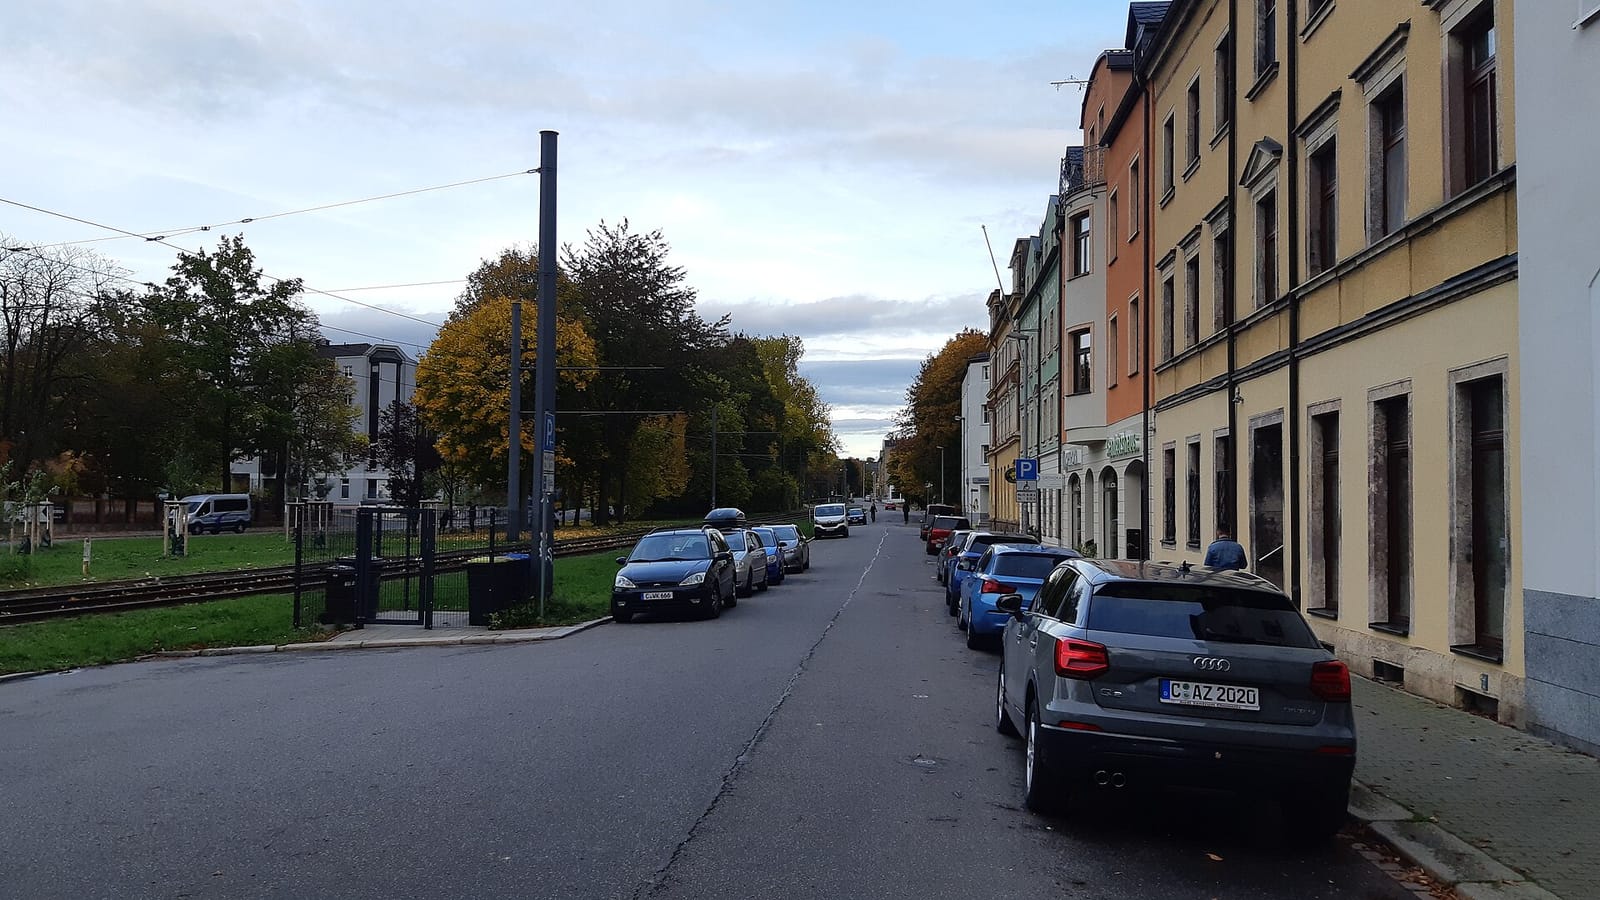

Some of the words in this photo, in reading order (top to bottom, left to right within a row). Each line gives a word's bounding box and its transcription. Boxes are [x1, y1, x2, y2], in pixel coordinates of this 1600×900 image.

[1020, 461, 1032, 478] P
[1171, 683, 1180, 698] C
[1193, 685, 1213, 701] AZ
[1216, 687, 1256, 704] 2020
